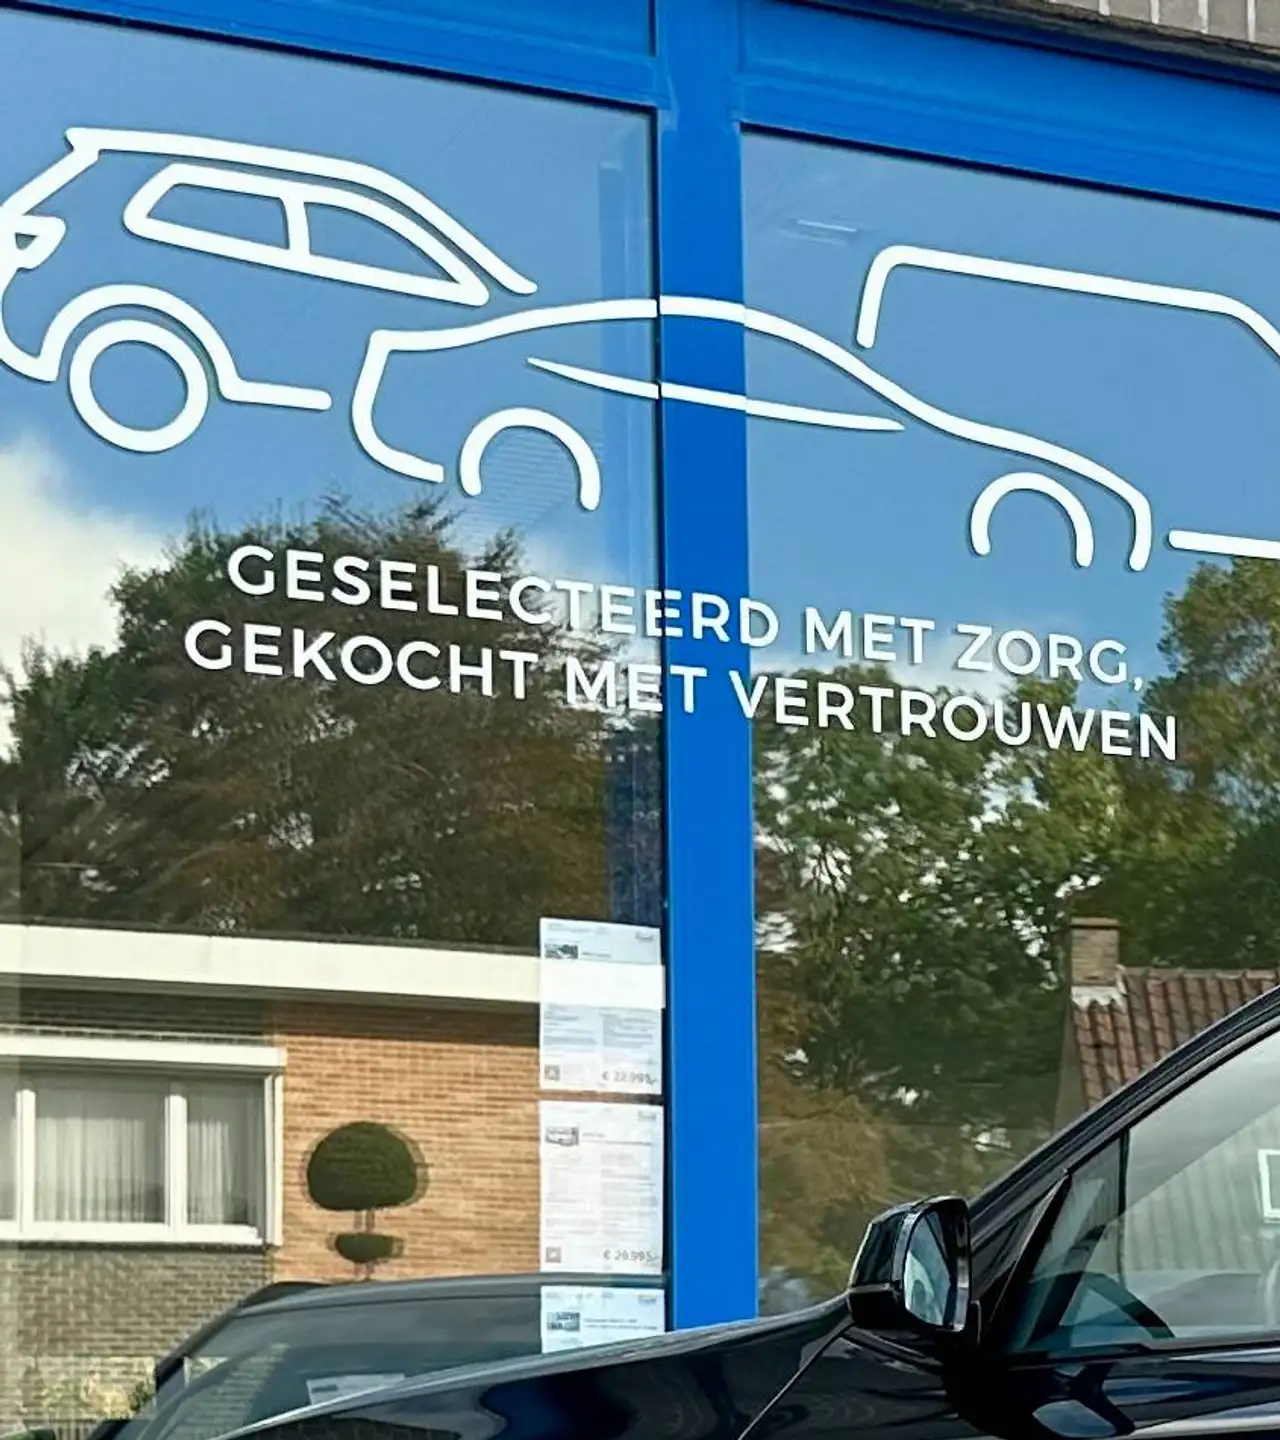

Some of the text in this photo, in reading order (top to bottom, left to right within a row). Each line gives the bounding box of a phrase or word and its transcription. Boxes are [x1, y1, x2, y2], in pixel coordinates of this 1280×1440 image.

[184, 619, 1178, 761] GEKOCHT MET VERTROUWEN
[227, 545, 1144, 692] GESELECTEERD MET ZORG,
